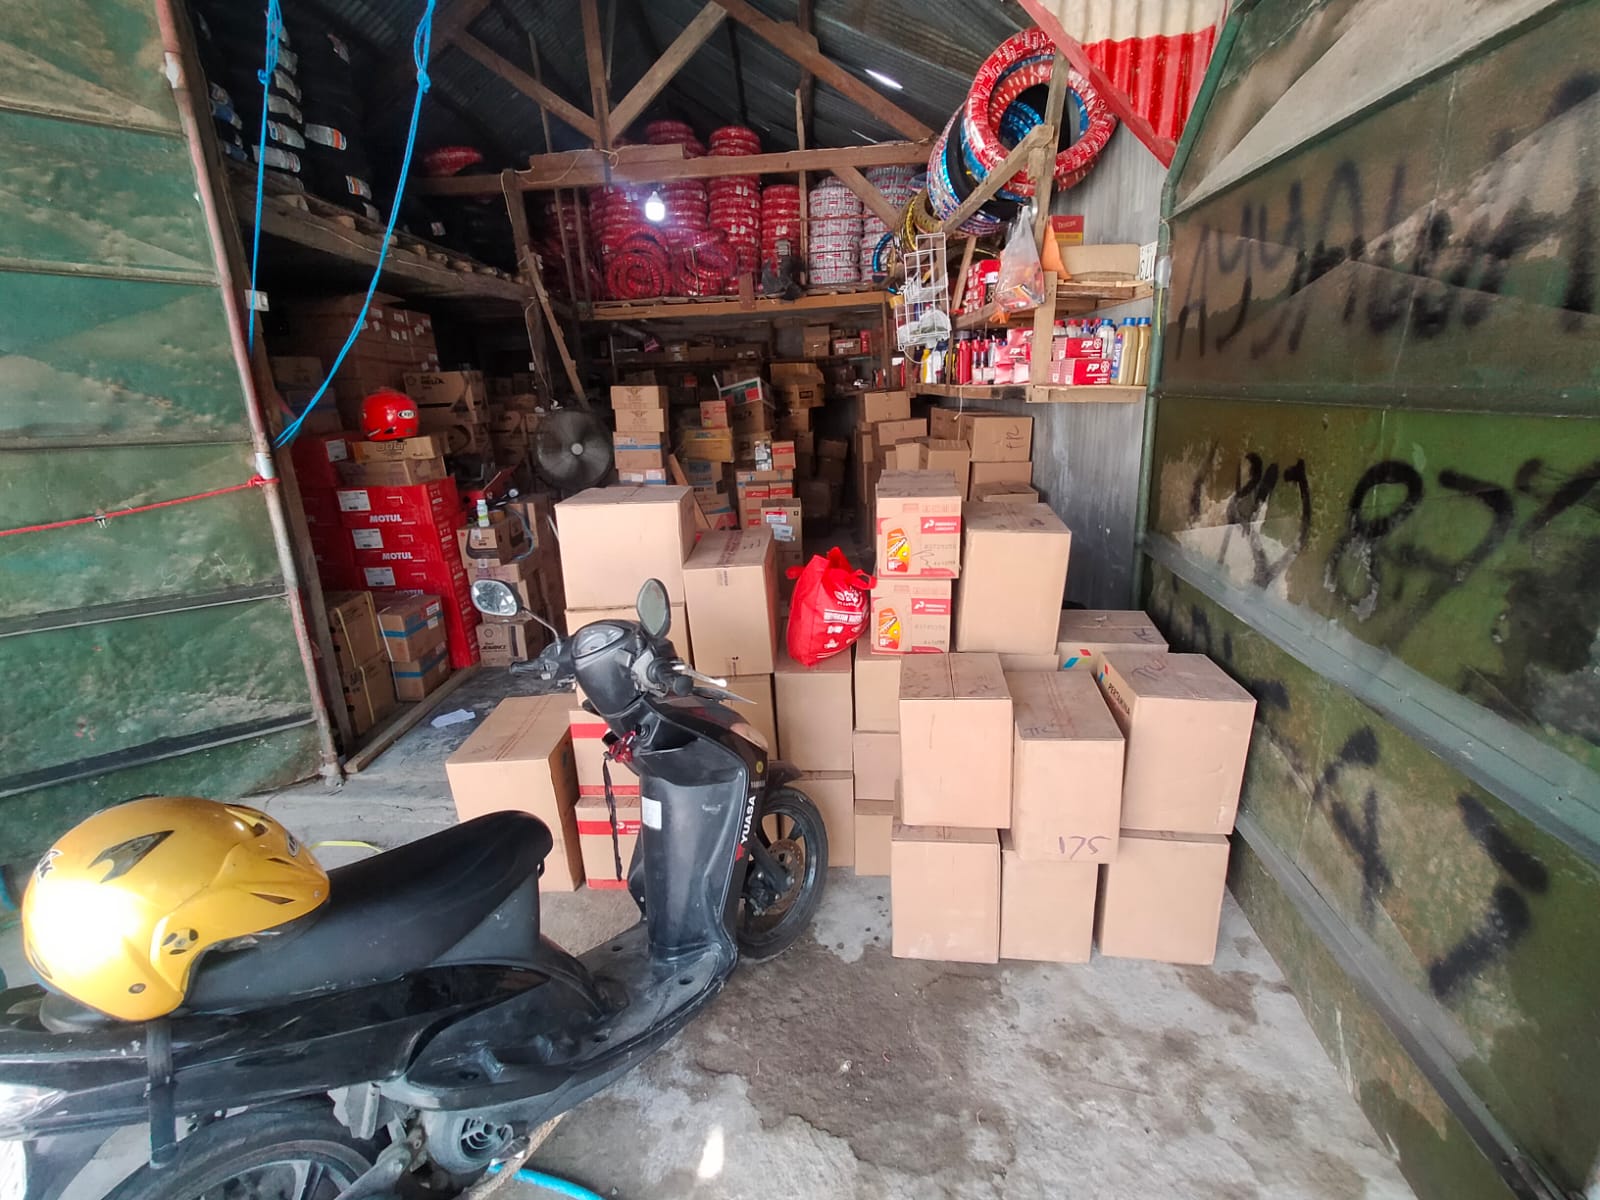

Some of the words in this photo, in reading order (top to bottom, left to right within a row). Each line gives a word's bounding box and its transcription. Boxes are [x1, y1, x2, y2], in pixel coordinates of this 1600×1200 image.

[1081, 340, 1093, 348] FP
[1086, 363, 1099, 372] FP
[369, 514, 402, 523] MOTUL
[382, 552, 413, 560] MOTUL
[740, 795, 756, 845] YUASA
[1058, 835, 1112, 860] 175
